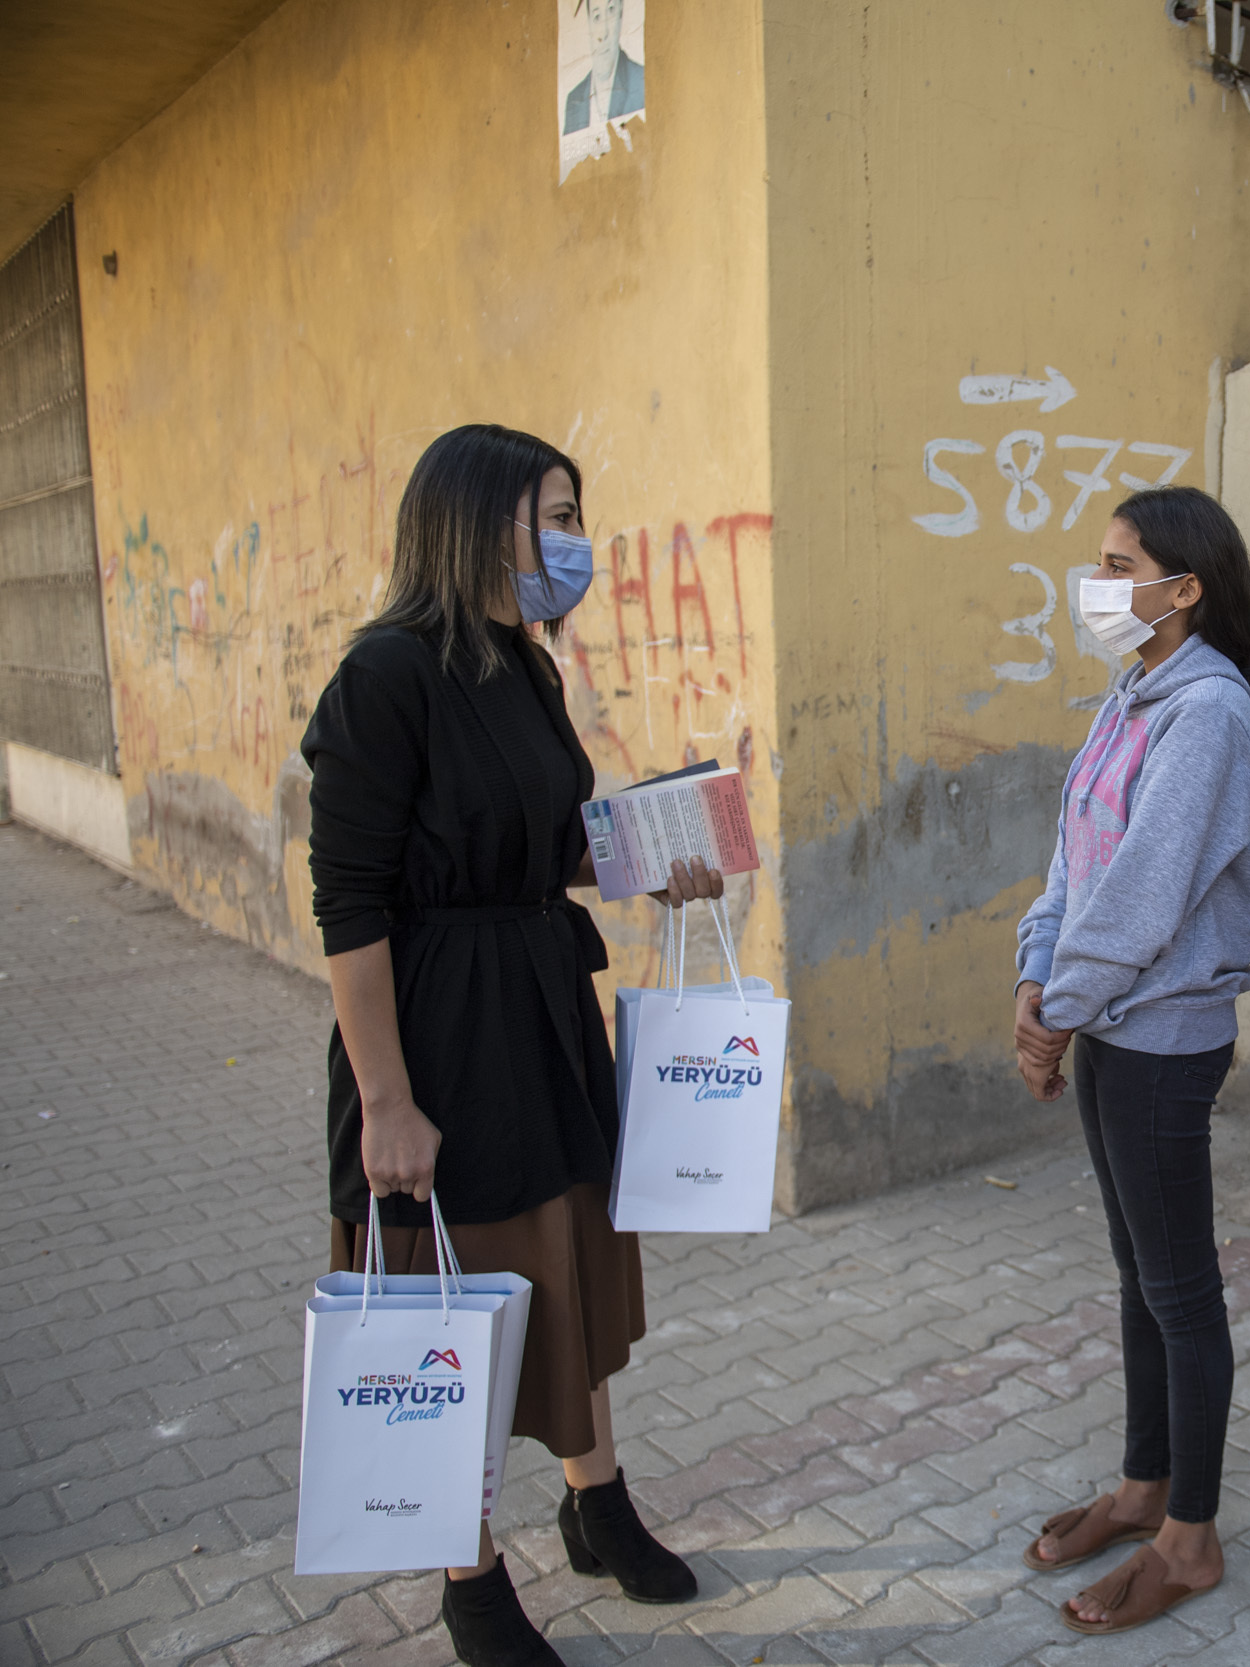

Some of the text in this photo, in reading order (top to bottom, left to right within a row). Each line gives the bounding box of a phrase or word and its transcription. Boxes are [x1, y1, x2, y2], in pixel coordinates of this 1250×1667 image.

[911, 430, 1193, 537] 5877
[610, 514, 773, 684] HAT
[656, 1064, 762, 1086] YERYÜZÜ
[695, 1081, 744, 1102] Cenneti
[676, 1166, 701, 1184] Vahap
[337, 1382, 465, 1406] YERYÜZÜ
[386, 1401, 444, 1426] Cenneti
[365, 1498, 396, 1516] Vahap
[398, 1498, 422, 1511] Seçer
